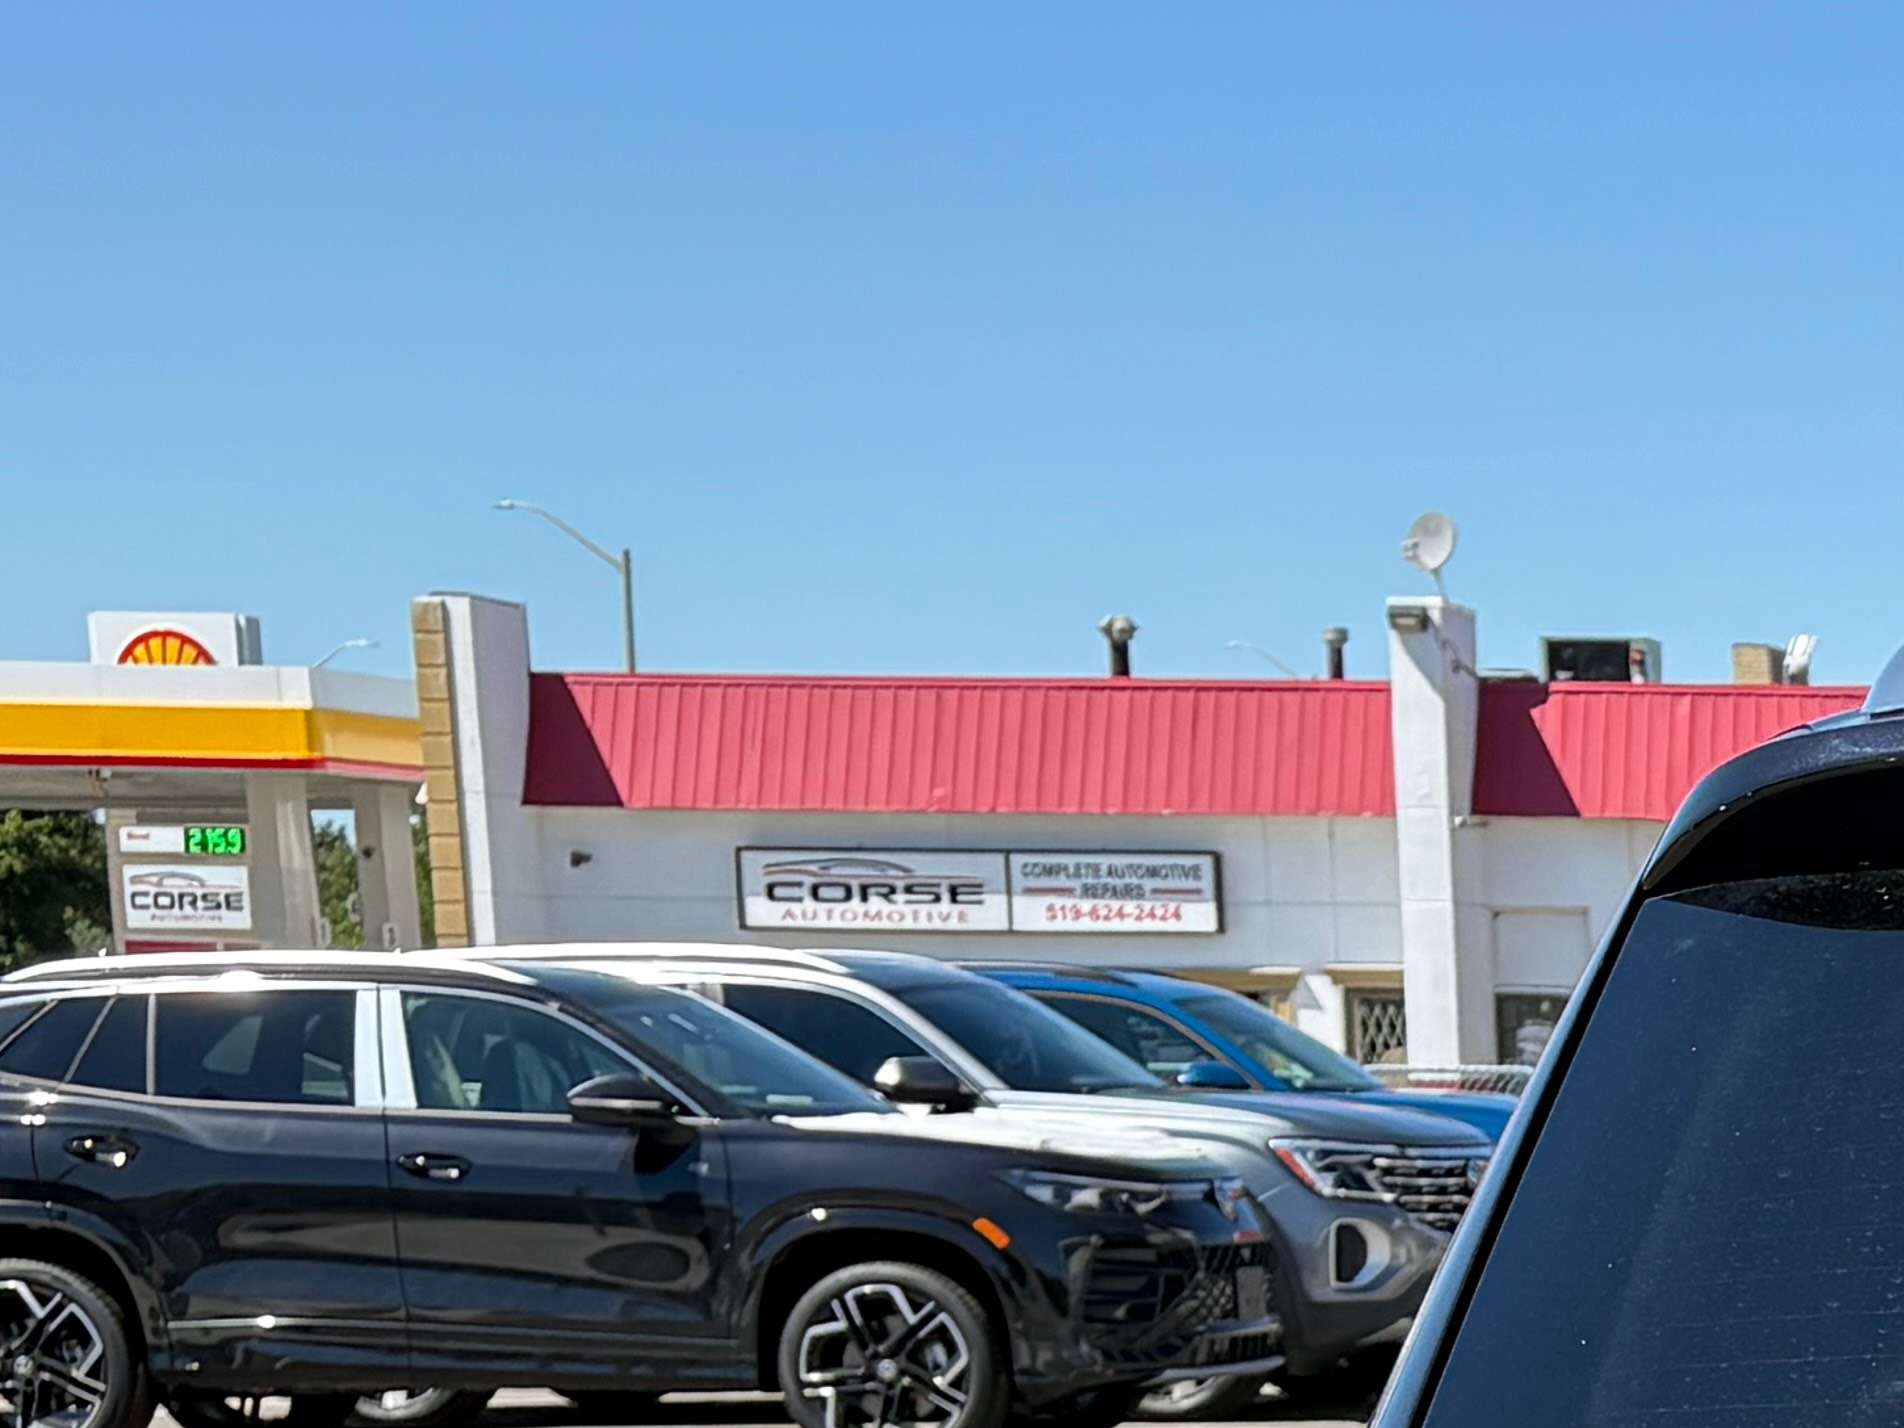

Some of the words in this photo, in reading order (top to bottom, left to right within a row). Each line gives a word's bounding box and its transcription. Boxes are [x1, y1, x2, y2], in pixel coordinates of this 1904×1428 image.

[1020, 862, 1101, 880] COMPLETE
[1106, 863, 1204, 882] AUTOMOTIVE
[130, 890, 245, 912] CORSE
[765, 881, 985, 905] CORSE
[781, 907, 970, 924] AUTOMOTIVE
